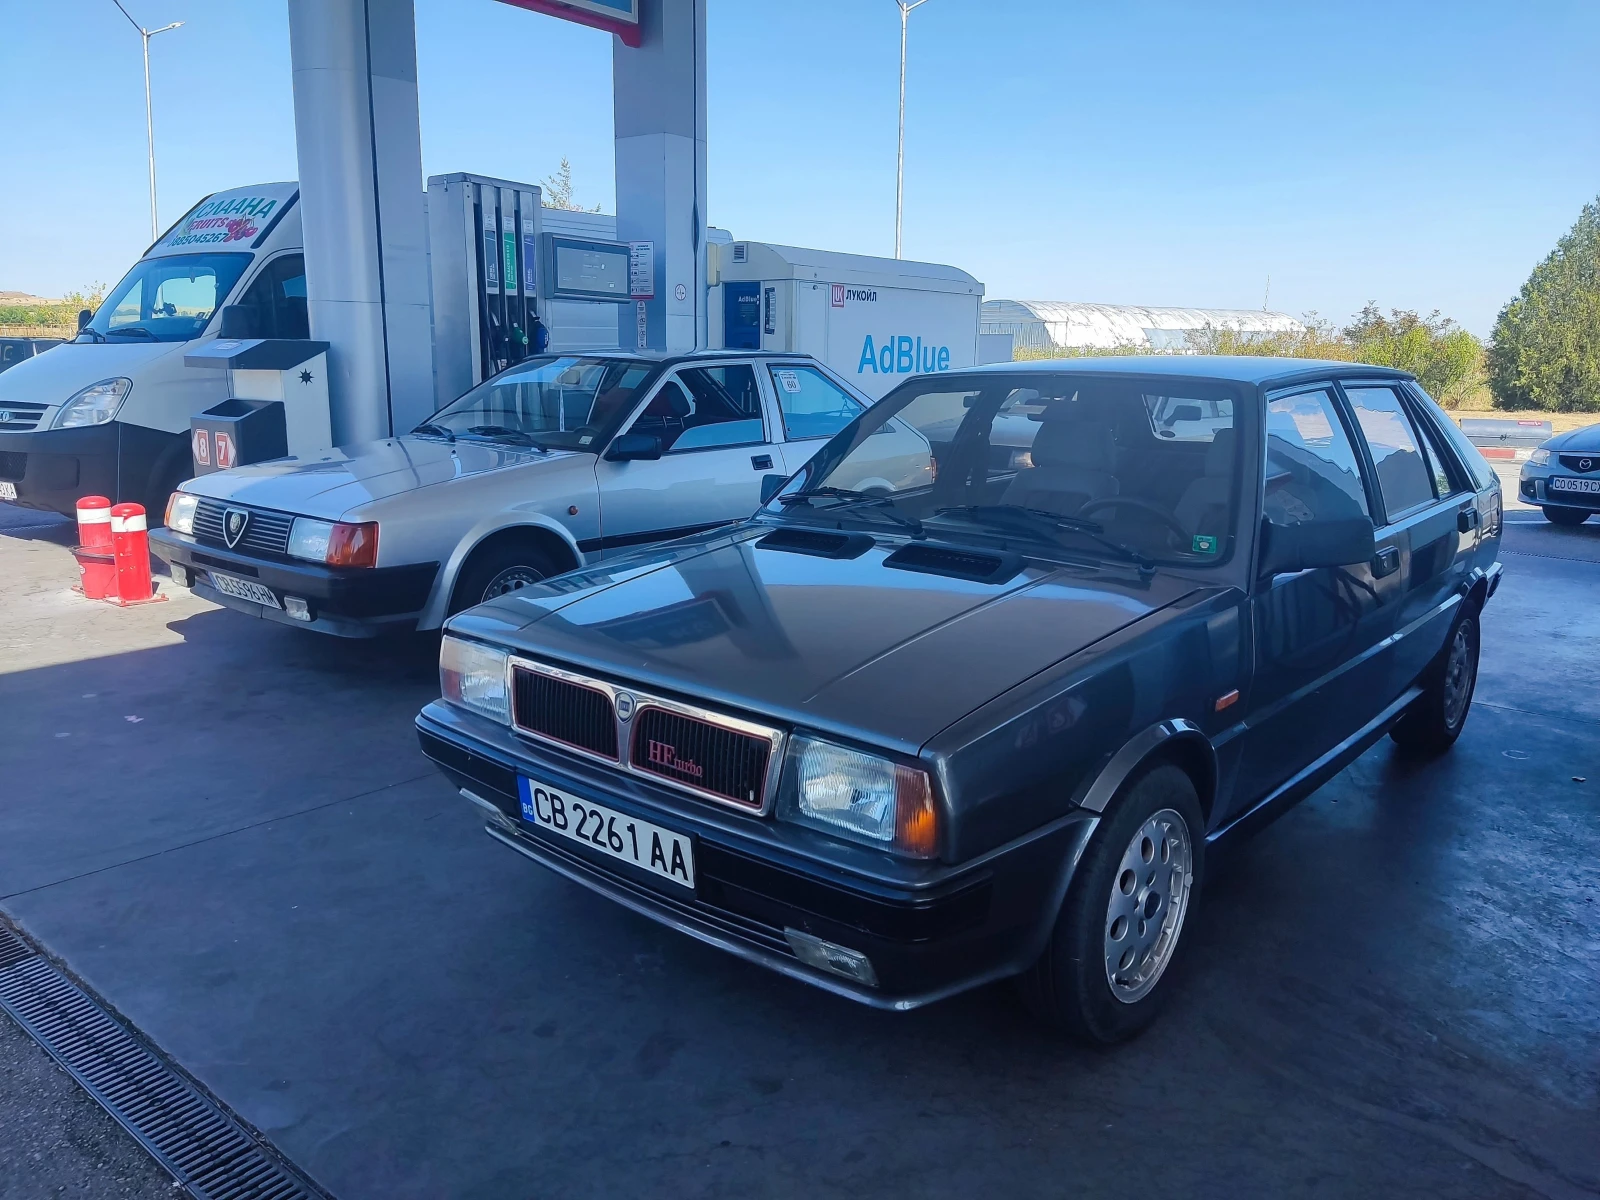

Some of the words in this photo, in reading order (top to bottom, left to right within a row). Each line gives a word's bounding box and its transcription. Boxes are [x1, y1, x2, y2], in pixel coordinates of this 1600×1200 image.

[189, 217, 229, 231] FRUITS
[846, 289, 877, 302] ЛУКОЙЛ
[857, 334, 950, 374] AdBlue
[786, 380, 797, 389] 60
[199, 437, 207, 458] 8
[217, 440, 226, 461] 7
[1554, 478, 1566, 489] CO
[1567, 480, 1589, 491] 0519
[648, 739, 676, 769] HF
[522, 801, 534, 816] BG
[533, 787, 569, 831] CB
[572, 802, 640, 861] 2261
[650, 829, 689, 881] AA
